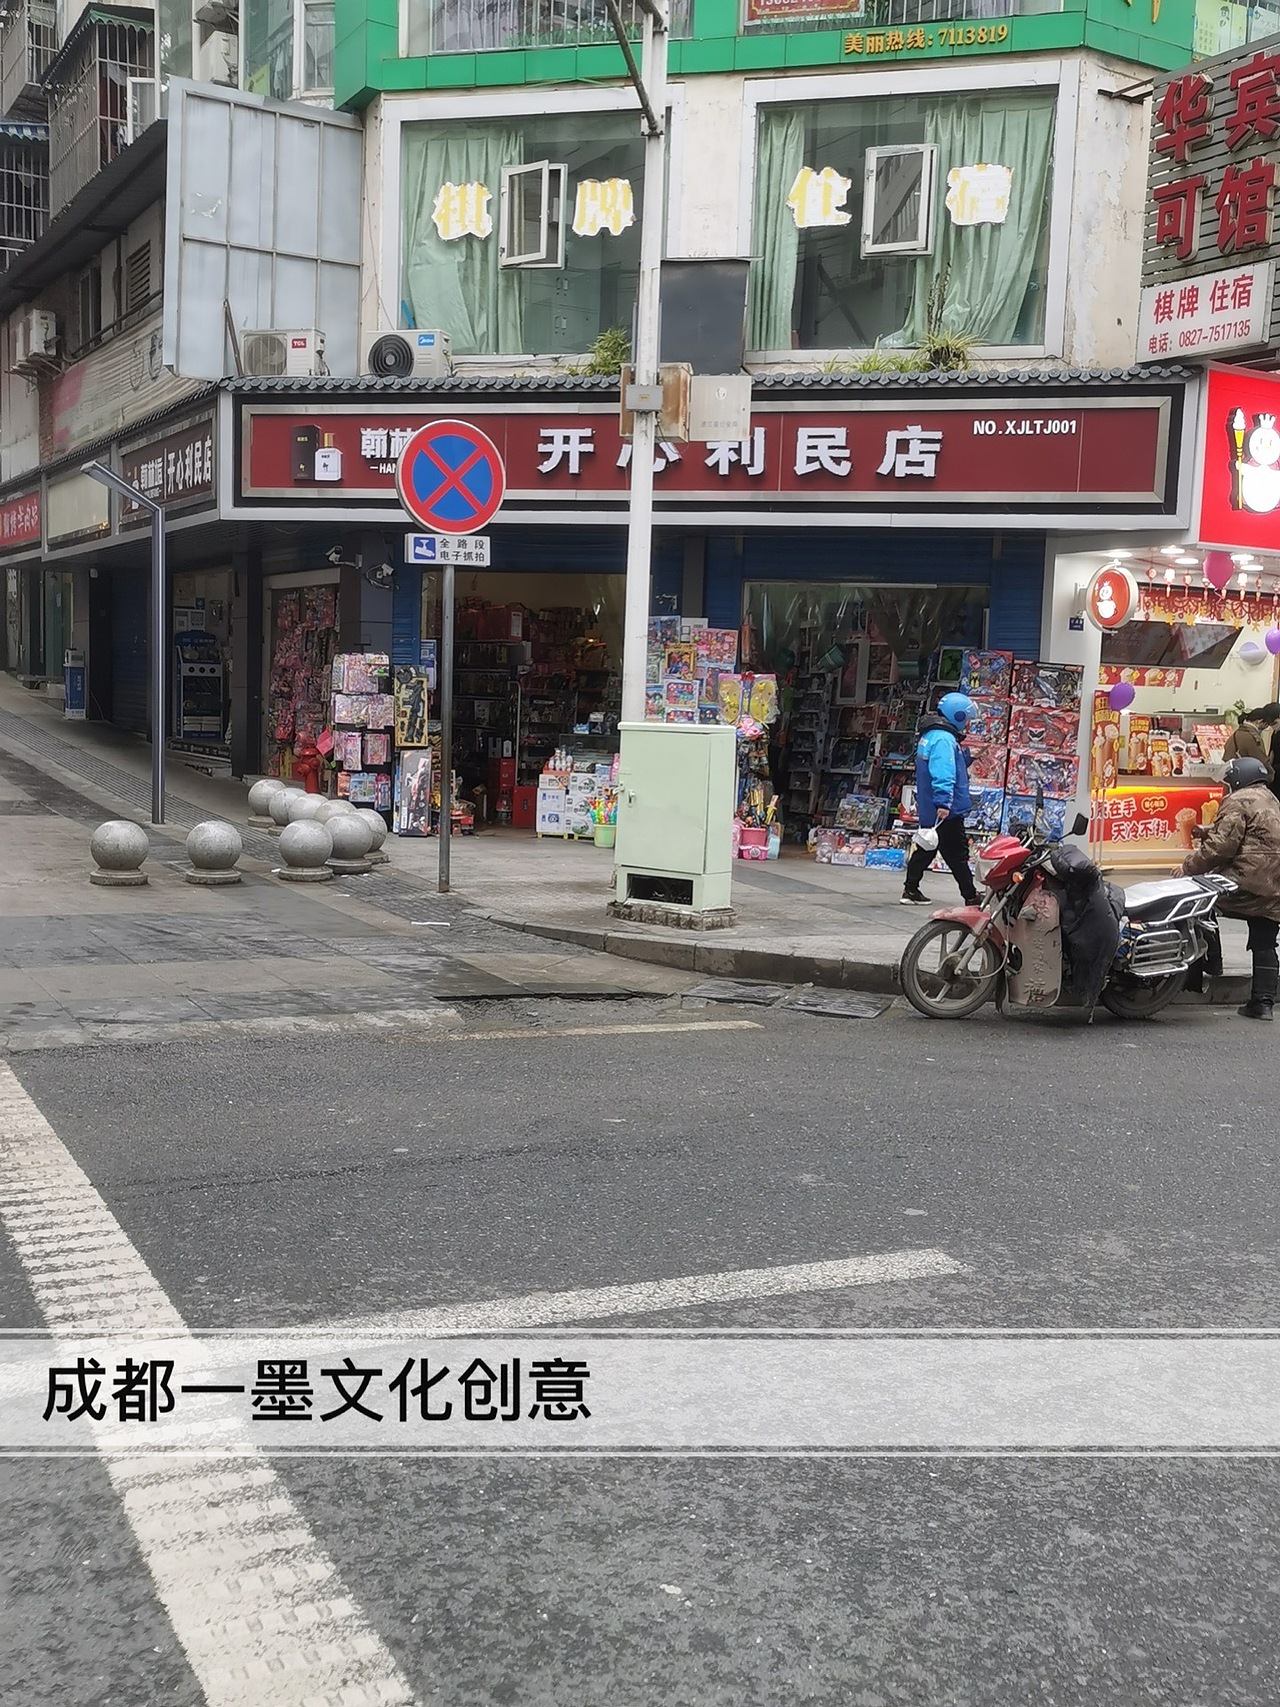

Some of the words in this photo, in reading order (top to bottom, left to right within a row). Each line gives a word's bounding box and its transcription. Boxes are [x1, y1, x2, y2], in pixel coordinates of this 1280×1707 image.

[1153, 285, 1199, 324] 棋牌
[1209, 274, 1254, 314] 住宿
[973, 418, 1078, 435] NO.XJLTJ001
[167, 435, 211, 495] 开心利民店
[440, 538, 485, 550] 全路段
[440, 551, 485, 562] 电子抓拍
[1112, 819, 1170, 841] 天冷不抖
